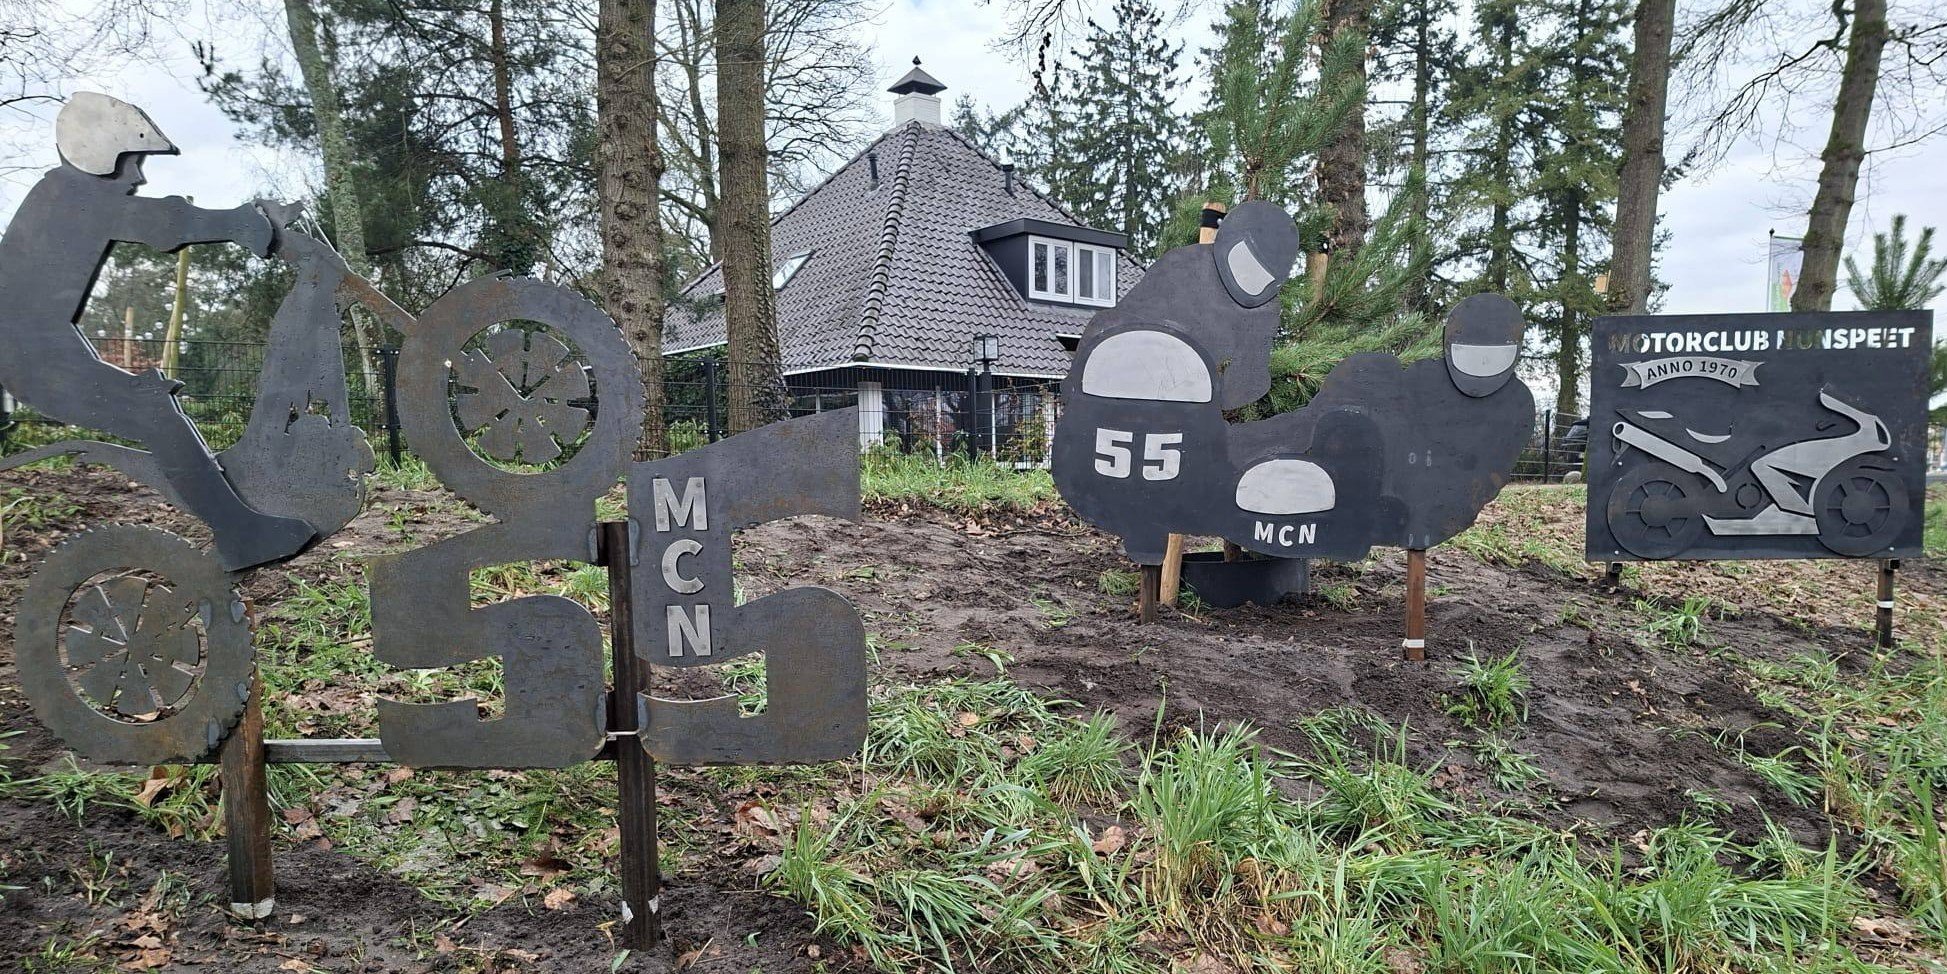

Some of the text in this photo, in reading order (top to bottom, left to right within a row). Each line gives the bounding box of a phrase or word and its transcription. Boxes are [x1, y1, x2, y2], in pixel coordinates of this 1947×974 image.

[1608, 327, 1915, 353] MOTORCLUB NUNSPEET
[1647, 360, 1738, 380] ANNO 1970
[1094, 428, 1183, 480] 55
[1254, 521, 1317, 546] MCN
[653, 476, 711, 656] MCN
